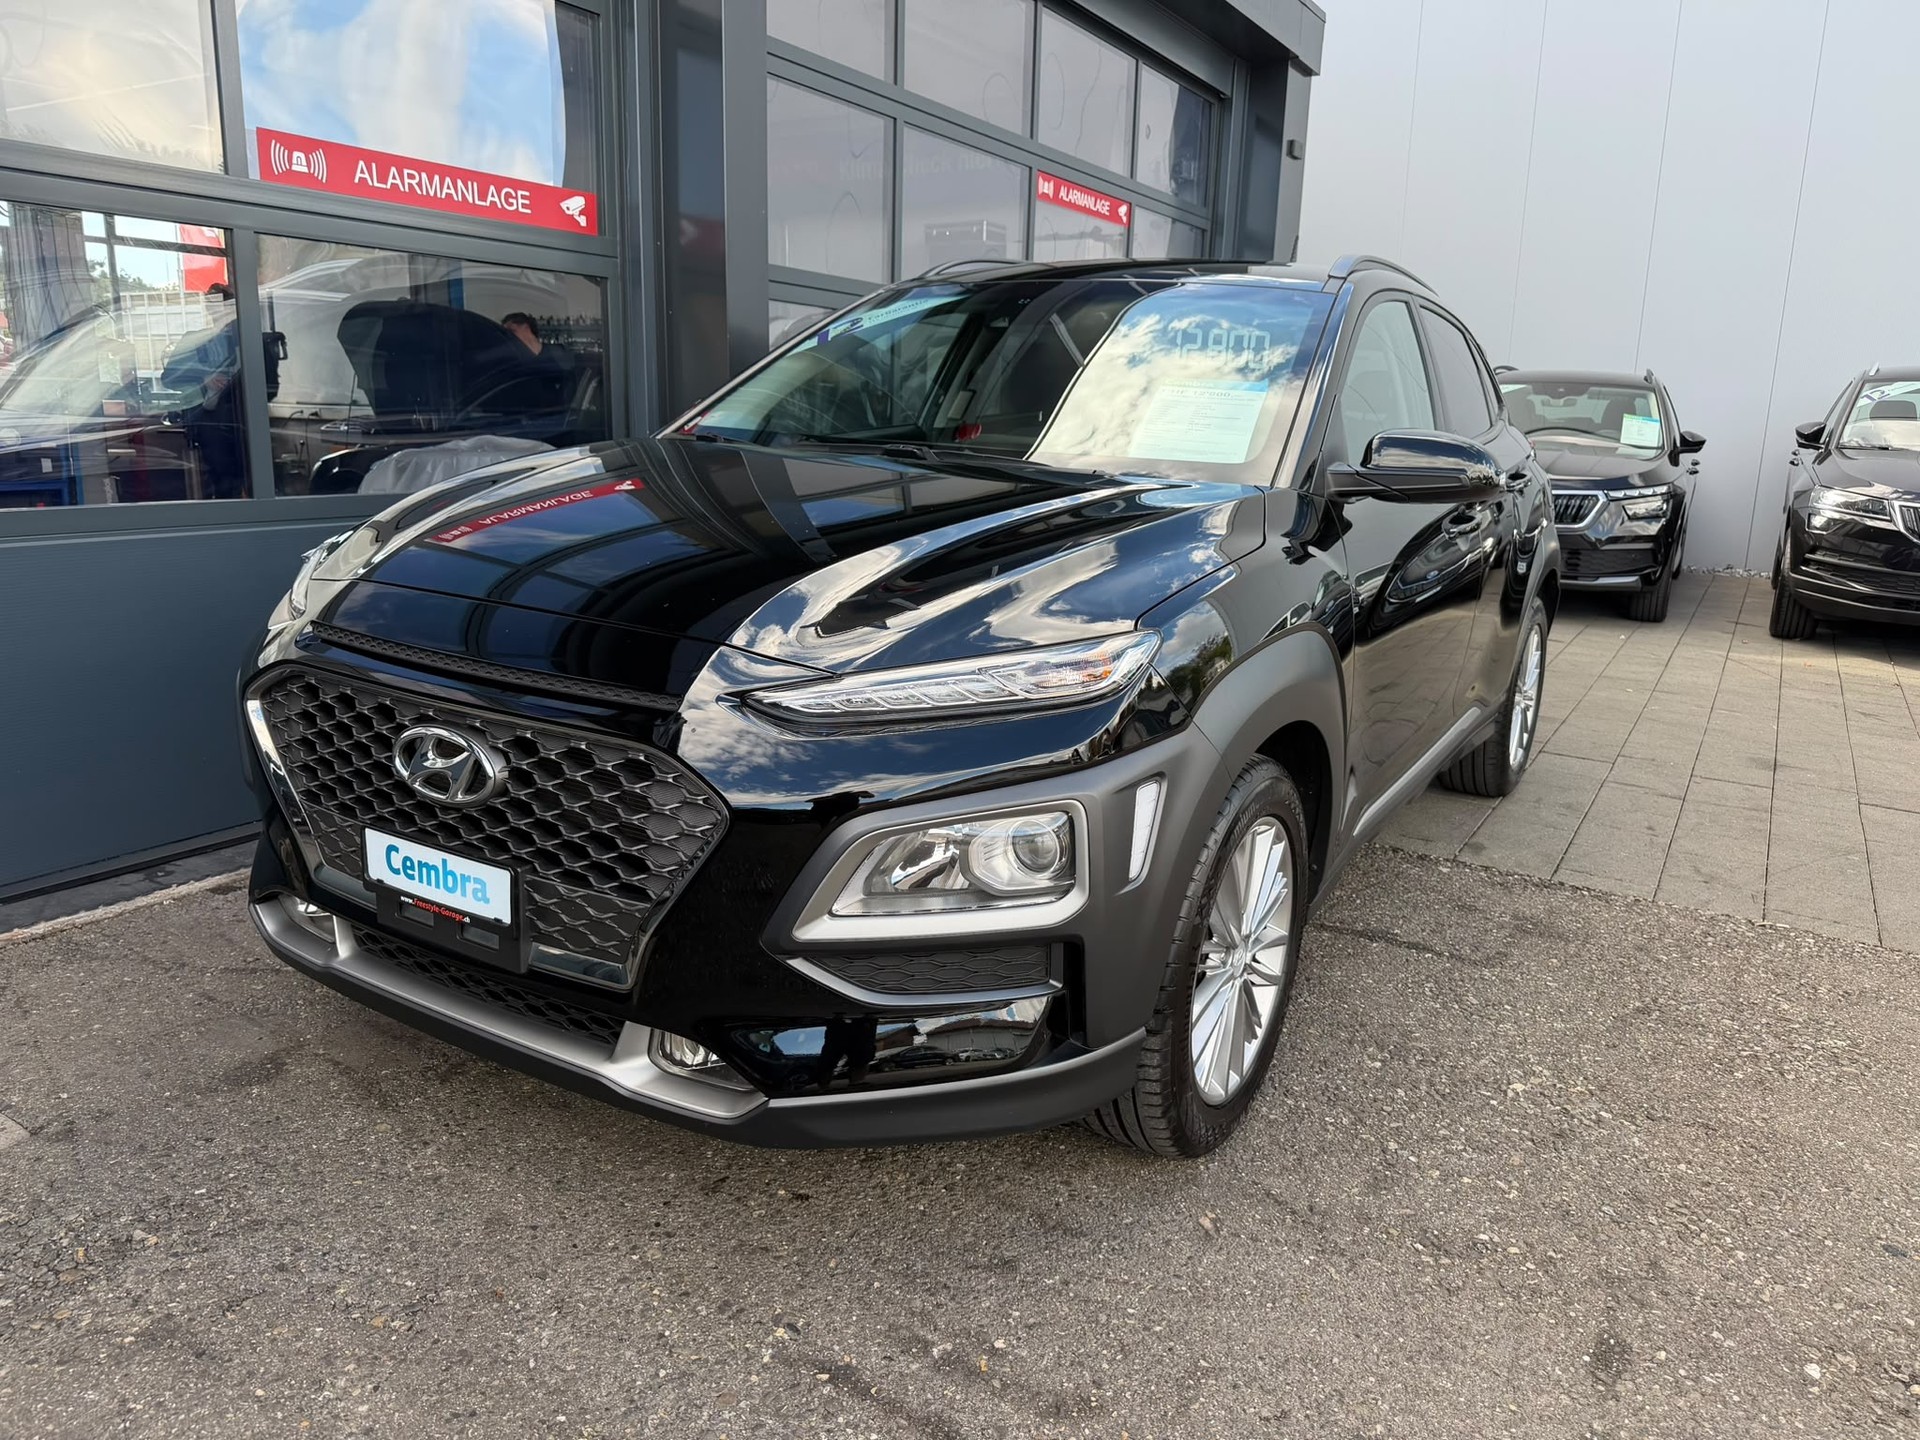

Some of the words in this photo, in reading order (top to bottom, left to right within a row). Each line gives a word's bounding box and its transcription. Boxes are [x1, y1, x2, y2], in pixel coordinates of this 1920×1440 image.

[354, 160, 532, 214] ALARMANLAGE
[1059, 185, 1111, 216] ALARMANLAGE
[385, 844, 490, 904] Cembra
[400, 895, 471, 923] www.Freestyle-Garage.ch
